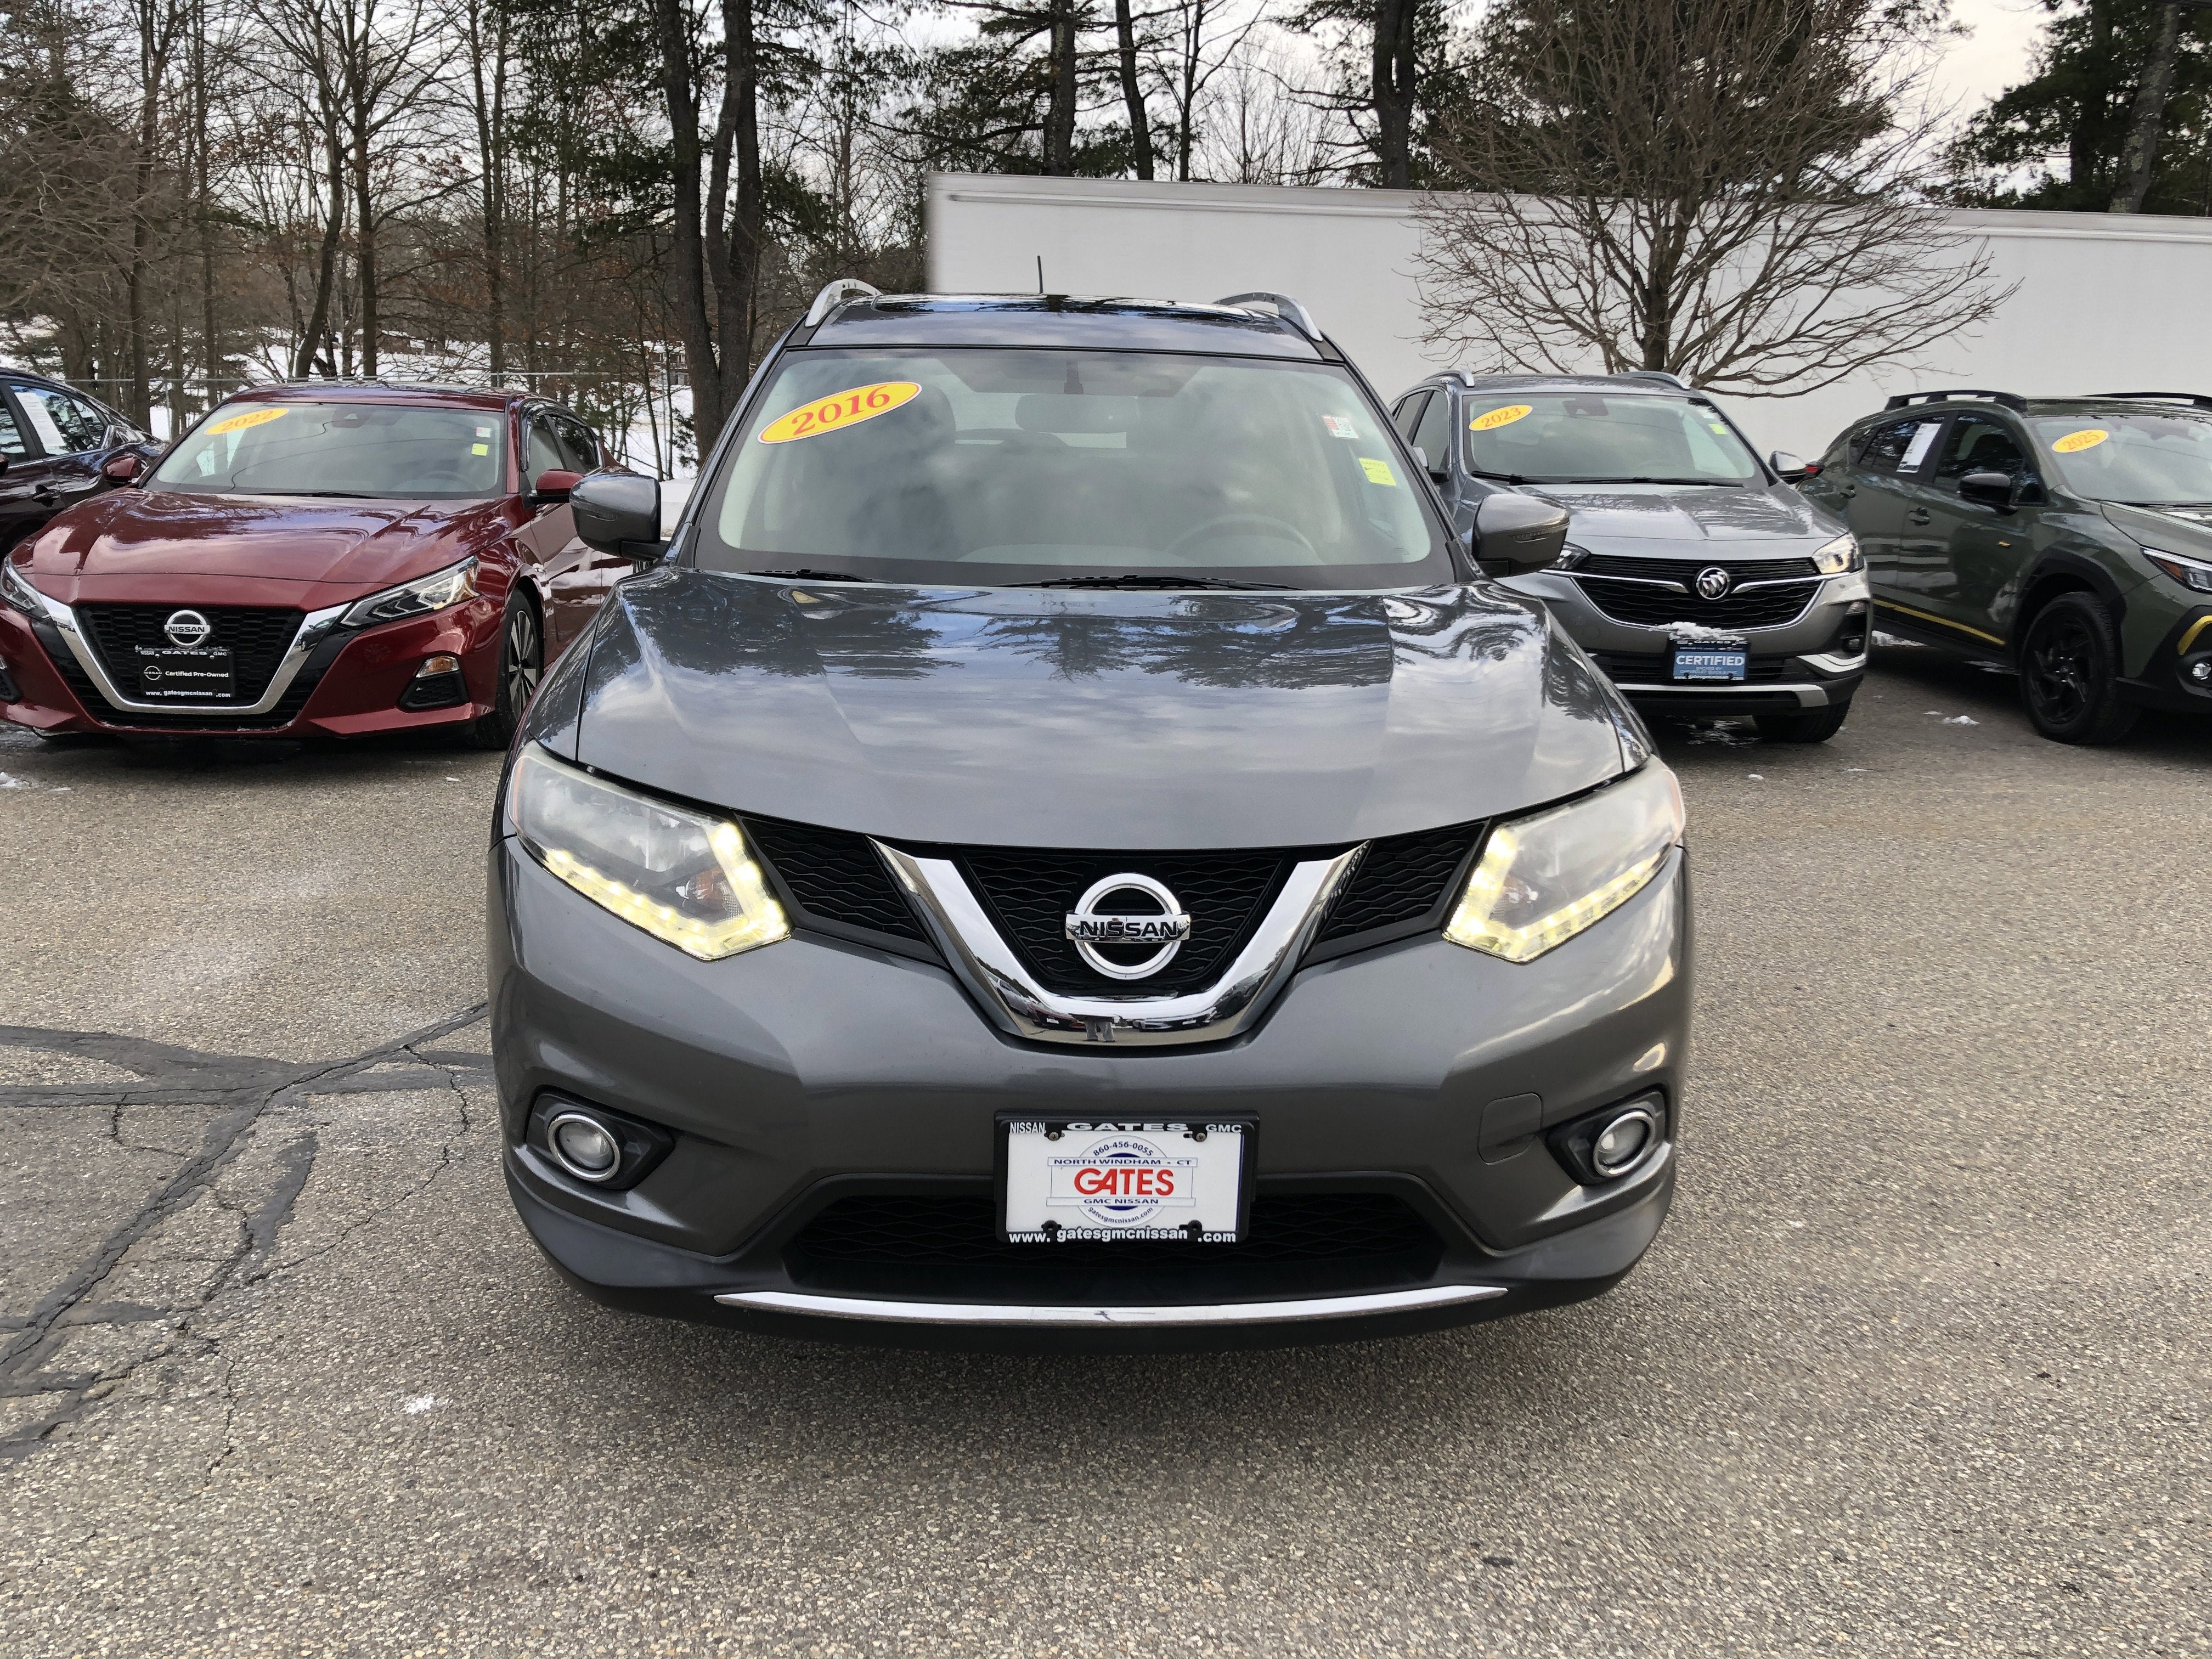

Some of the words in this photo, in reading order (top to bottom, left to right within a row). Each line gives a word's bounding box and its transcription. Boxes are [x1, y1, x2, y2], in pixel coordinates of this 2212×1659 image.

[791, 386, 890, 436] 2016
[1481, 407, 1521, 427] 2023
[221, 410, 274, 432] 2022
[2062, 432, 2100, 450] 2025
[1676, 655, 1745, 666] CERTIFIED
[1080, 921, 1178, 938] NISSAN
[1009, 1122, 1045, 1133] NISSAN
[1066, 1122, 1188, 1131] GATES
[1205, 1124, 1242, 1132] GMC
[1093, 1141, 1154, 1156] 860-456-0055
[1074, 1167, 1174, 1196] GATES
[1088, 1206, 1153, 1223] gatesgmcnissan.com
[1009, 1232, 1051, 1243] www.
[1057, 1227, 1188, 1242] gatesgmcnissan
[1198, 1233, 1237, 1243] .com
